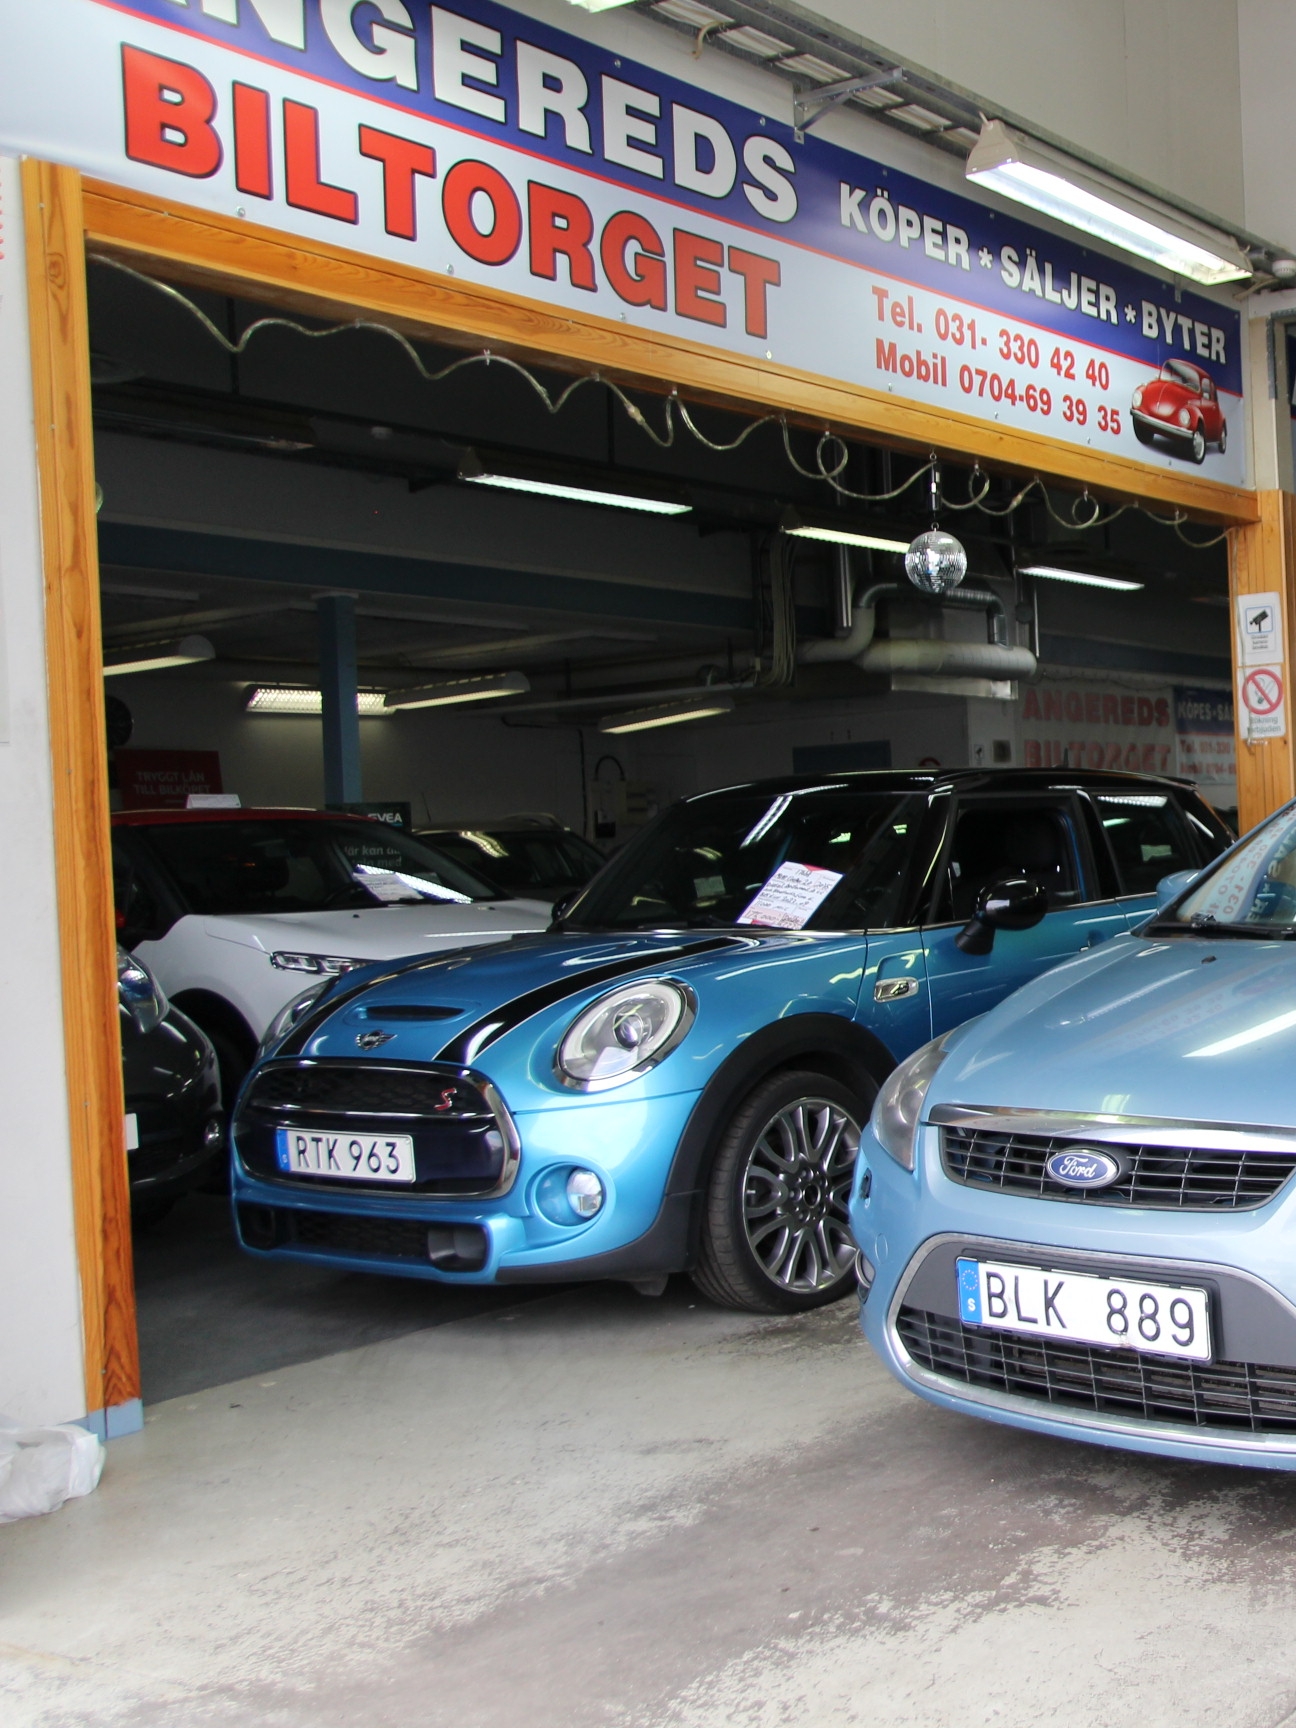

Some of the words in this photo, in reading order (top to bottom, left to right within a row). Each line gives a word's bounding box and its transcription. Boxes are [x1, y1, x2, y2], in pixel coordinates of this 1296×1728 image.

[120, 40, 783, 341] BILTORGET
[838, 181, 971, 272] KÖPER
[1000, 246, 1119, 325] SÄLJER
[1141, 299, 1227, 365] BYTER
[871, 285, 923, 334] Tel.
[935, 307, 988, 352] 031-
[998, 328, 1040, 370] 330
[1050, 350, 1076, 381] 42
[1085, 358, 1111, 391] 40
[875, 337, 948, 387] Mobil
[958, 364, 1052, 417] 0704-69
[1062, 395, 1088, 427] 39
[1097, 404, 1122, 436] 35
[1023, 687, 1170, 727] ANGEREDS
[296, 1135, 341, 1171] RTK
[349, 1139, 401, 1174] 963
[1058, 1155, 1097, 1178] Ford
[967, 1297, 976, 1312] S
[985, 1271, 1067, 1329] BLK
[1106, 1288, 1195, 1347] 889
